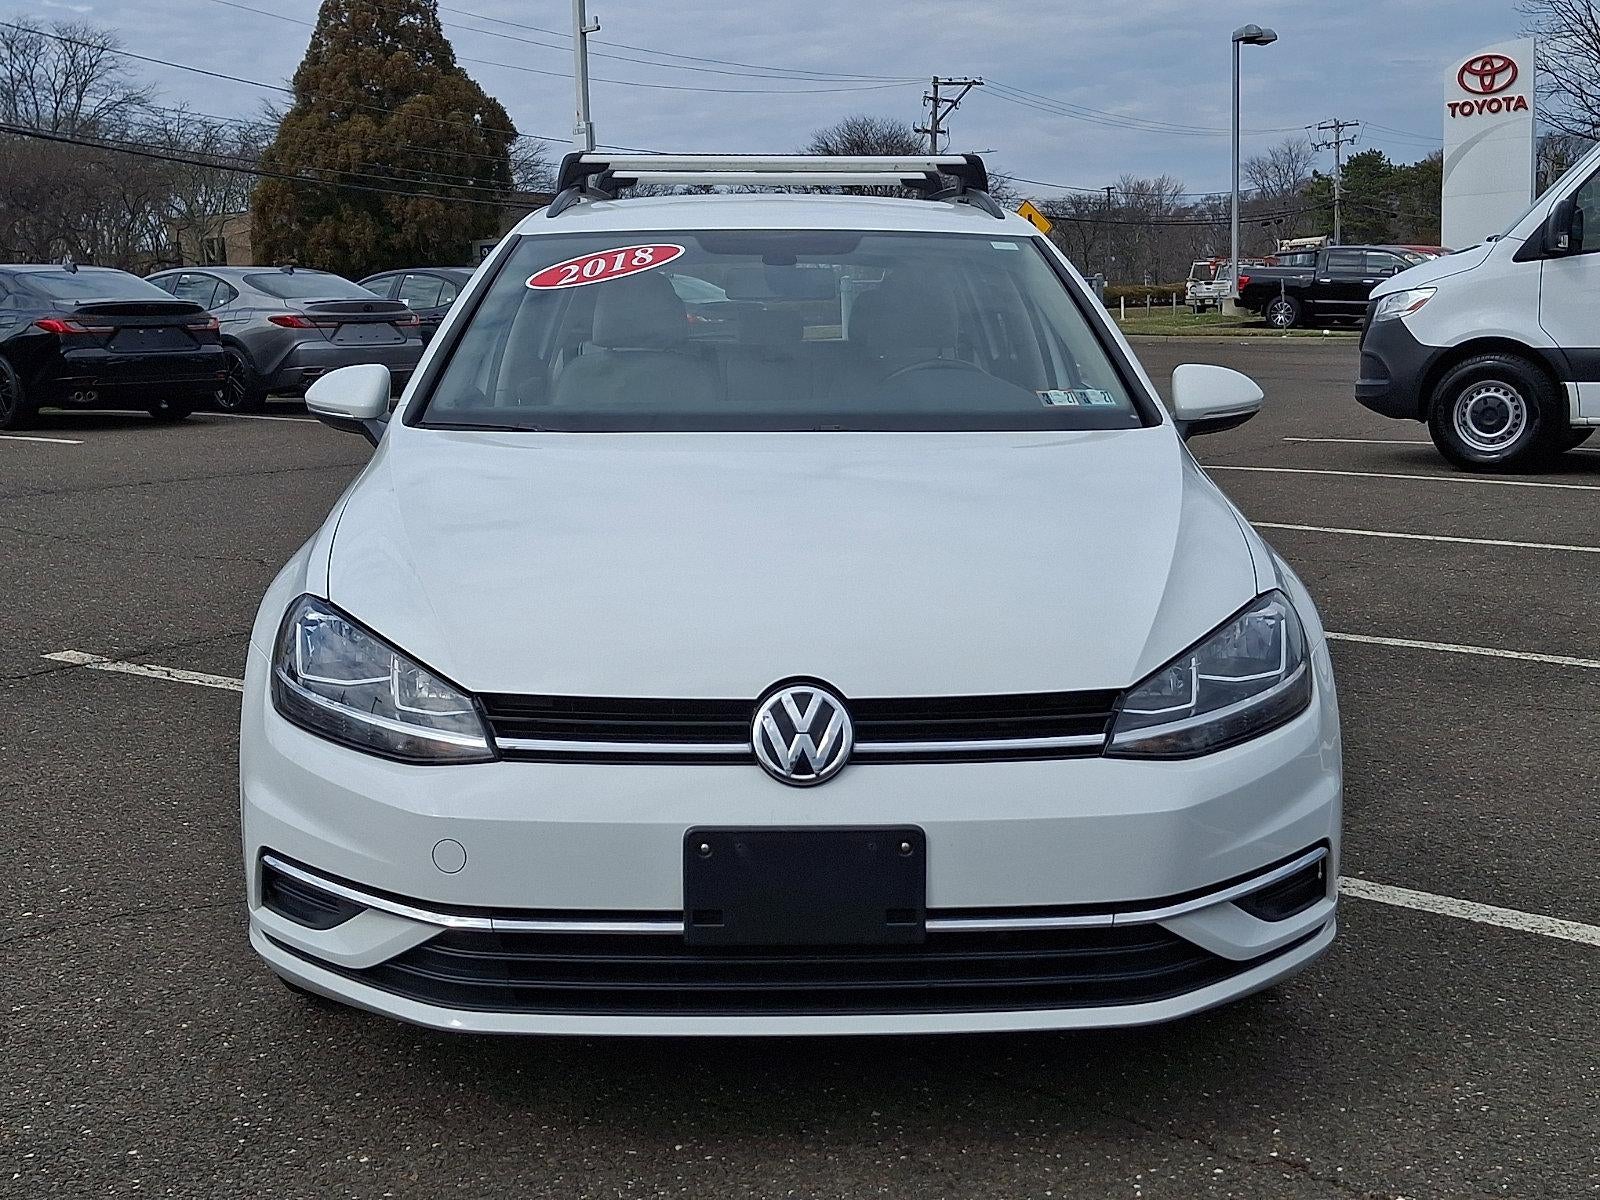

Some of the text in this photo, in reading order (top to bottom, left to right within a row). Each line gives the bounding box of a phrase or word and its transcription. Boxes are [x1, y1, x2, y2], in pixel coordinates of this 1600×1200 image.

[1447, 95, 1528, 118] TOYOTA
[556, 247, 654, 286] 2018
[756, 688, 850, 778] VW
